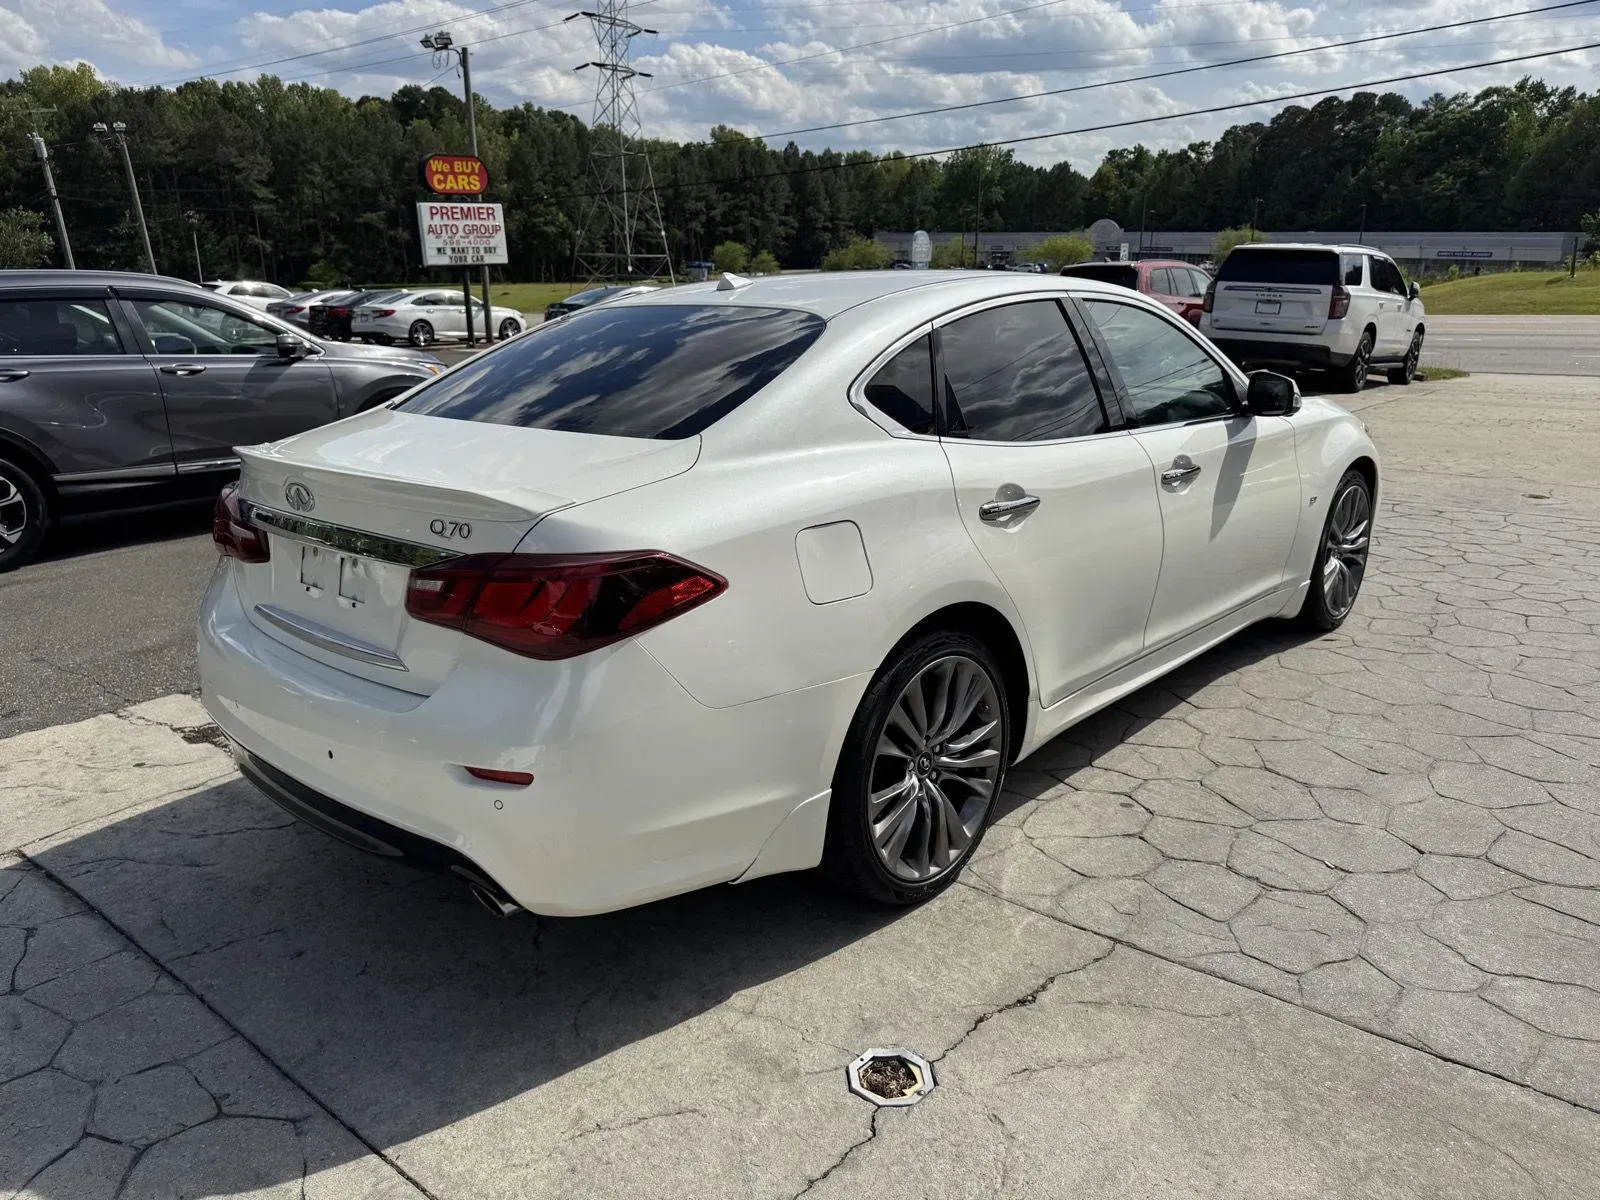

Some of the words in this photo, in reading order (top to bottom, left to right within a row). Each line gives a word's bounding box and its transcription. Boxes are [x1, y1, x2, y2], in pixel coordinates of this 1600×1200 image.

[430, 160, 451, 172] We
[454, 161, 481, 173] BUY
[433, 174, 481, 190] CARS
[429, 206, 496, 221] PREMIER
[427, 224, 459, 236] AUTO
[463, 224, 502, 236] GROUP
[436, 247, 446, 255] WE
[451, 247, 470, 255] WANT
[471, 247, 481, 255] TO
[483, 247, 497, 255] BUY
[449, 255, 468, 264] YOUR
[471, 255, 485, 264] CAR
[430, 519, 473, 540] Q70
